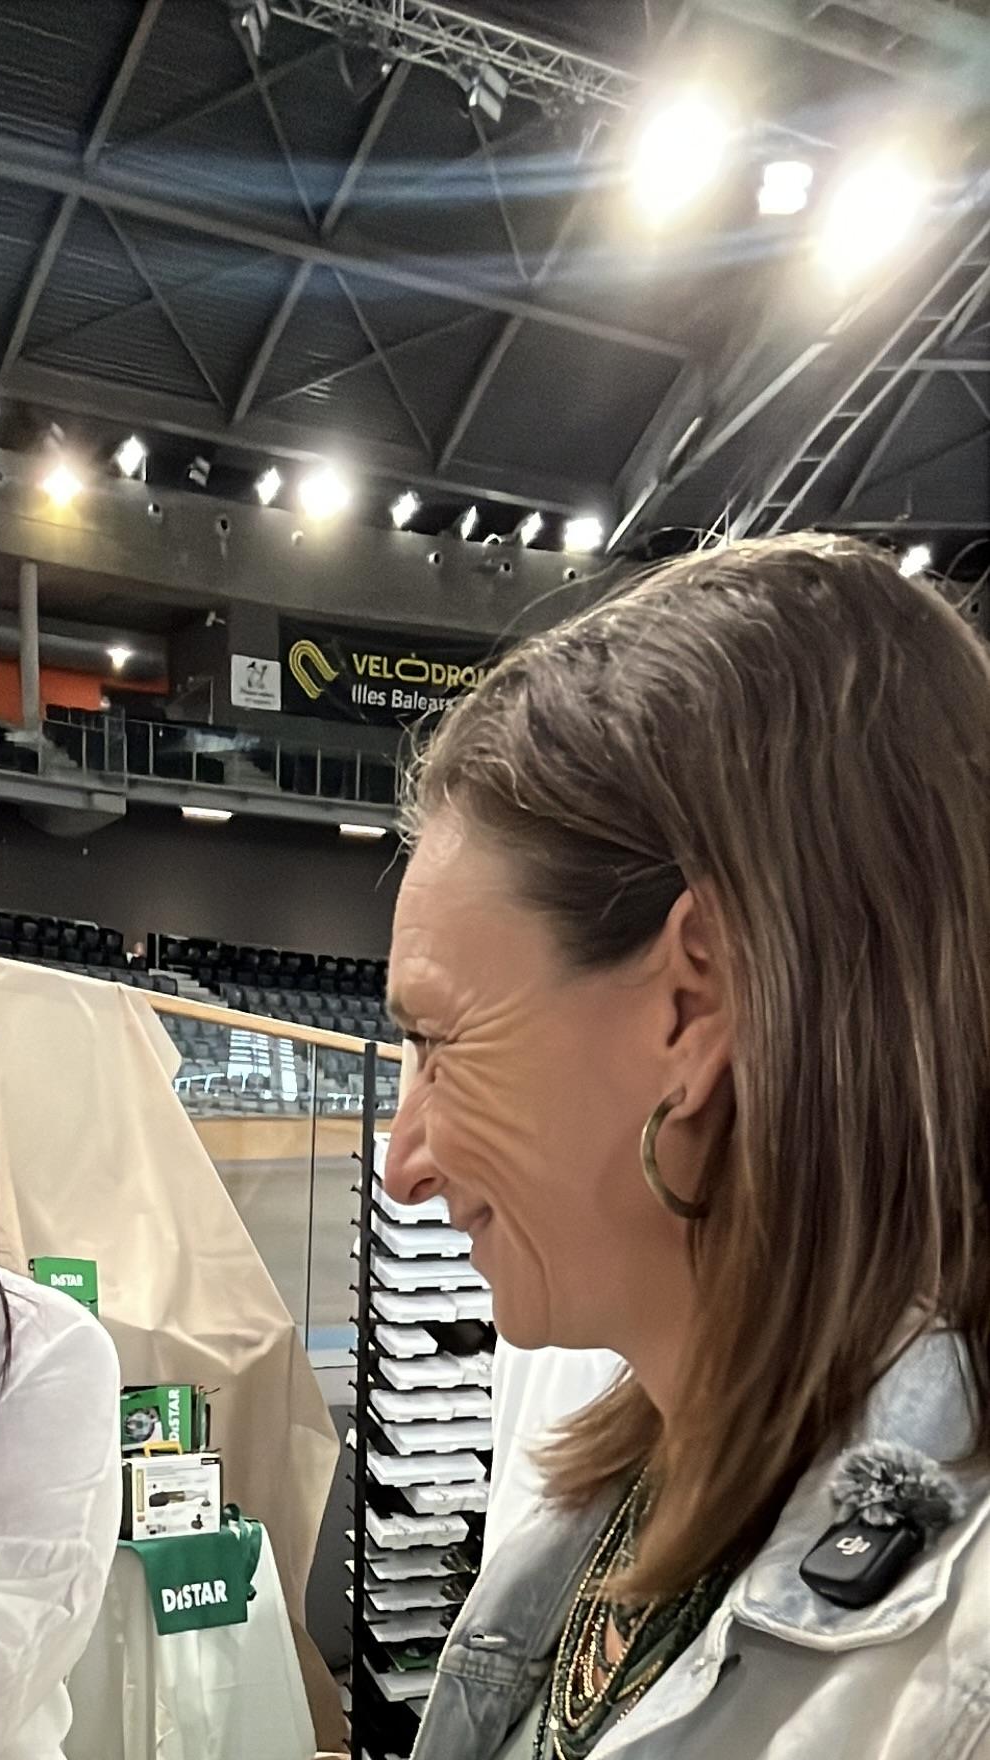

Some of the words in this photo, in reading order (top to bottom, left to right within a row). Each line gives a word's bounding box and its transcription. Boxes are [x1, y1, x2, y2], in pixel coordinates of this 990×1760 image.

[351, 684, 386, 707] Illes
[391, 688, 456, 712] Balears
[161, 1579, 228, 1614] DiSTAR
